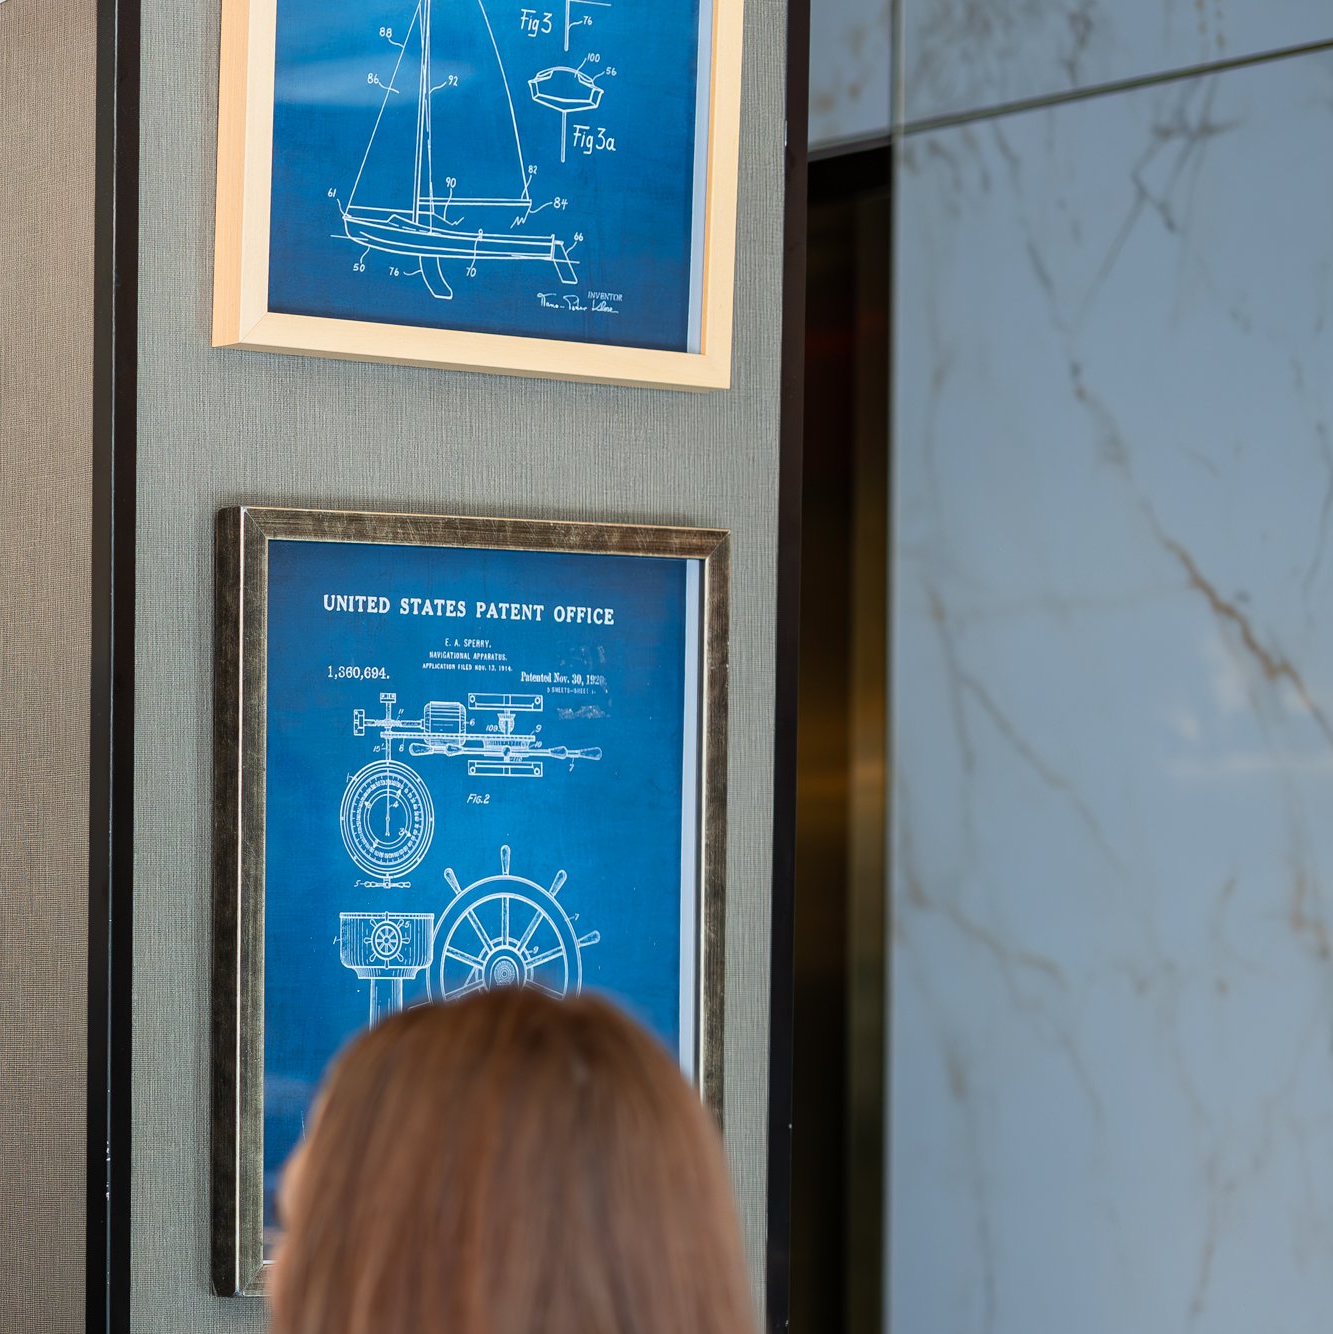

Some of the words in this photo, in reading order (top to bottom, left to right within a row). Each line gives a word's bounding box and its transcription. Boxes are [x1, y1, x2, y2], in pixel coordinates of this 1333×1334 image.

[583, 15, 593, 26] 76
[379, 26, 392, 38] 88
[587, 52, 601, 63] 100
[605, 66, 617, 77] 56
[367, 72, 379, 84] 86
[448, 74, 458, 87] 92
[528, 165, 537, 174] 82
[445, 176, 456, 188] 90
[553, 196, 568, 210] 84
[574, 231, 584, 242] 66
[353, 263, 366, 273] 50
[389, 266, 400, 277] 76
[466, 266, 477, 278] 70
[587, 291, 623, 302] INVENTOR
[323, 594, 391, 614] UNITED
[399, 598, 467, 617] STATES
[476, 602, 545, 621] PATENT
[553, 606, 615, 626] OFFICE
[444, 637, 452, 647] E.
[454, 639, 461, 647] A.
[429, 650, 471, 660] NAVIGATIONAL
[422, 662, 456, 671] APPLICATION
[520, 671, 552, 684] Patented
[553, 672, 570, 684] Nov.
[571, 673, 584, 687] 30,
[535, 724, 542, 733] 9
